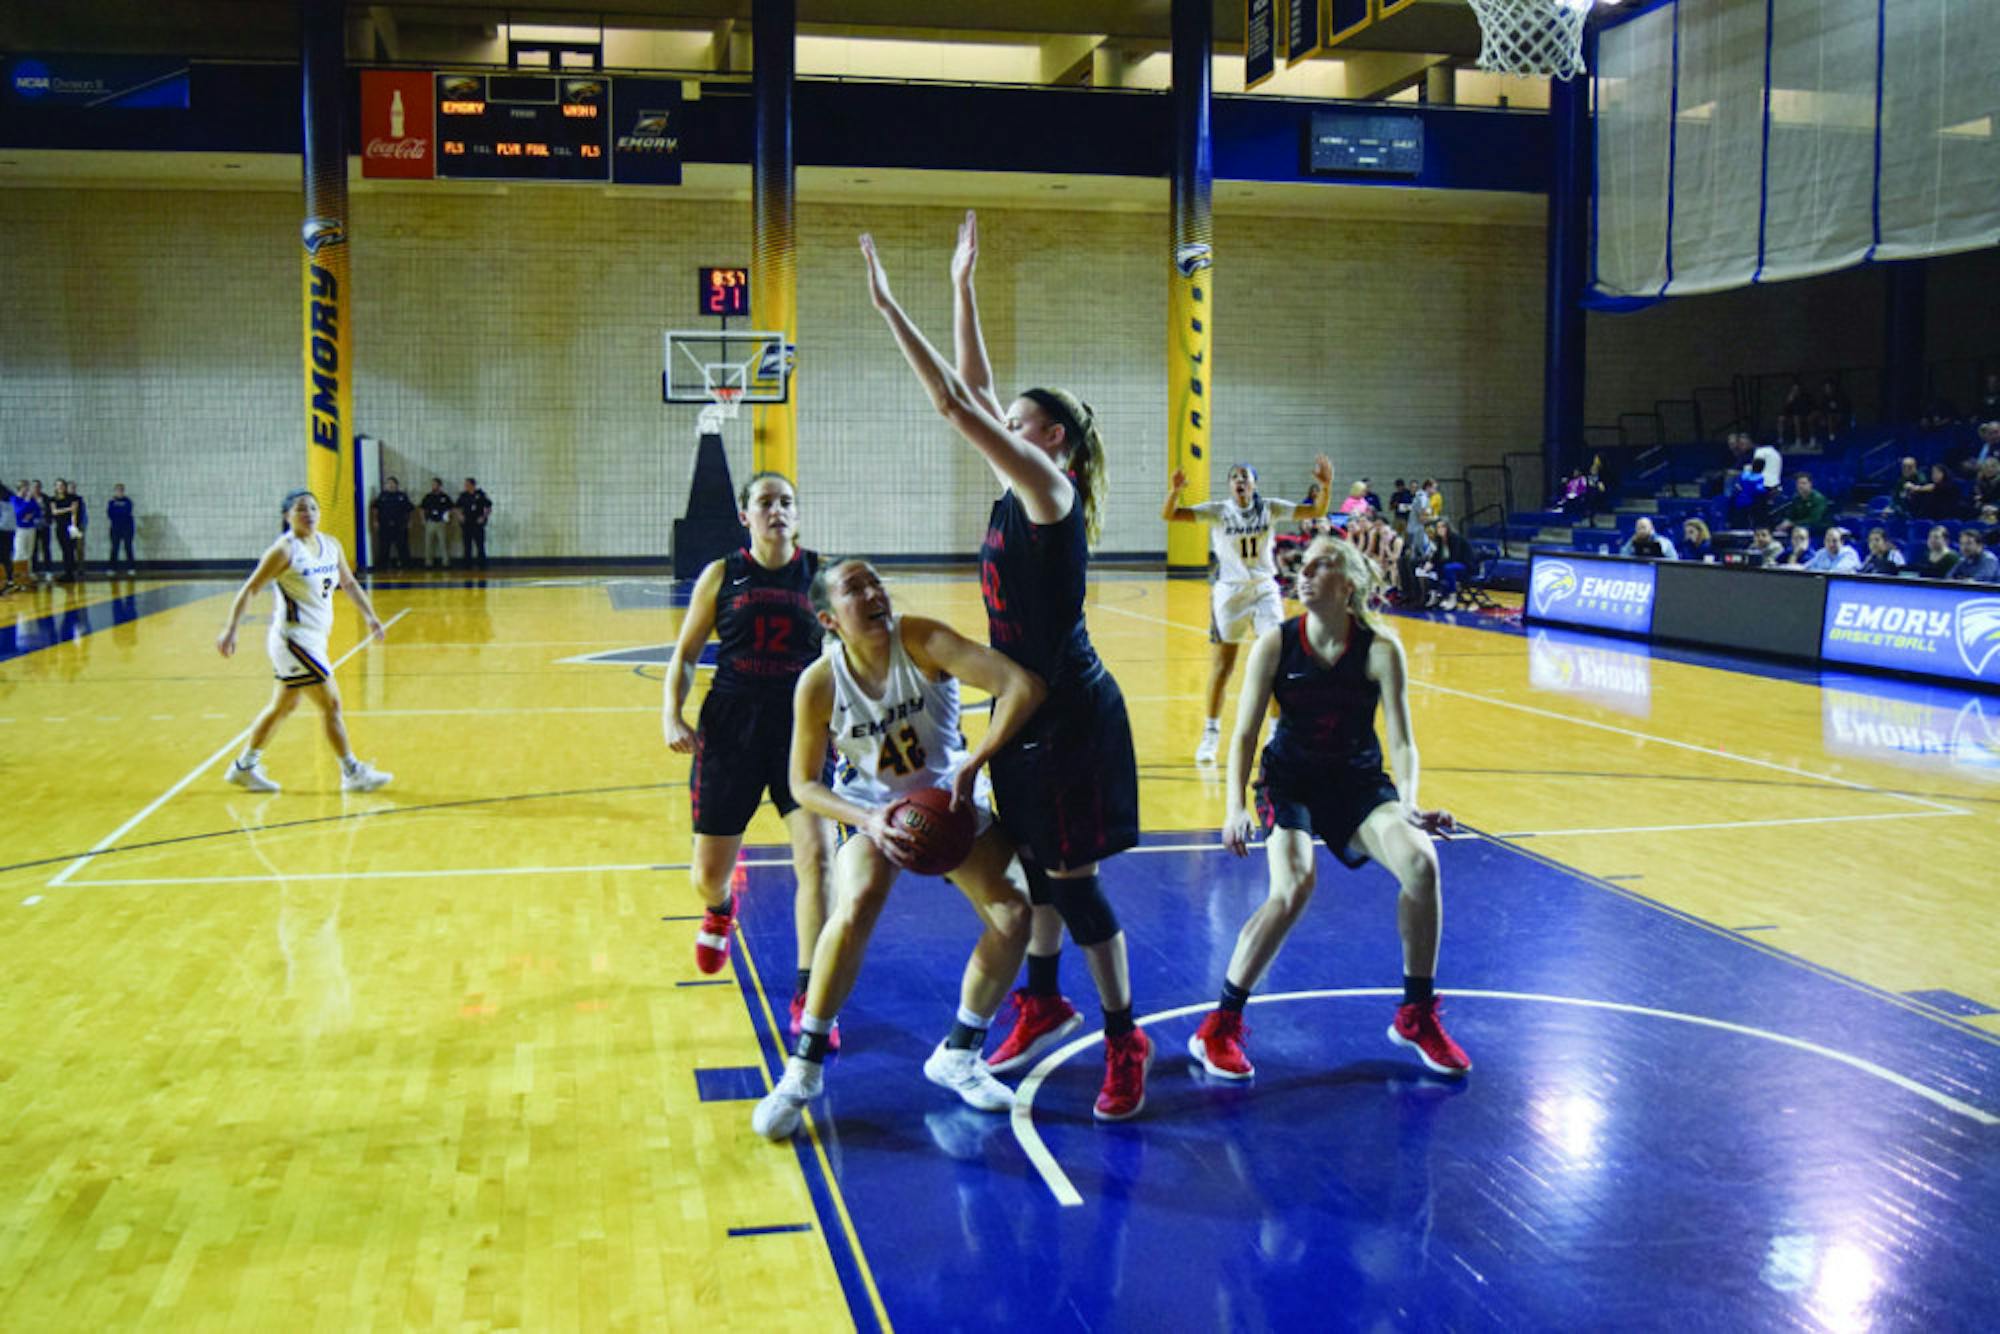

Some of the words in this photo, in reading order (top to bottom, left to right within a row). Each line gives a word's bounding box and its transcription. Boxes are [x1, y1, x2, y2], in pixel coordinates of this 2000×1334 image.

[442, 101, 485, 115] EMORY
[617, 137, 678, 148] EMORY
[710, 287, 740, 312] 21
[311, 264, 339, 453] EMORY
[1240, 537, 1258, 559] 11
[1581, 576, 1651, 604] EMORY
[752, 614, 794, 654] 12
[1829, 627, 1937, 652] BASKETBALL
